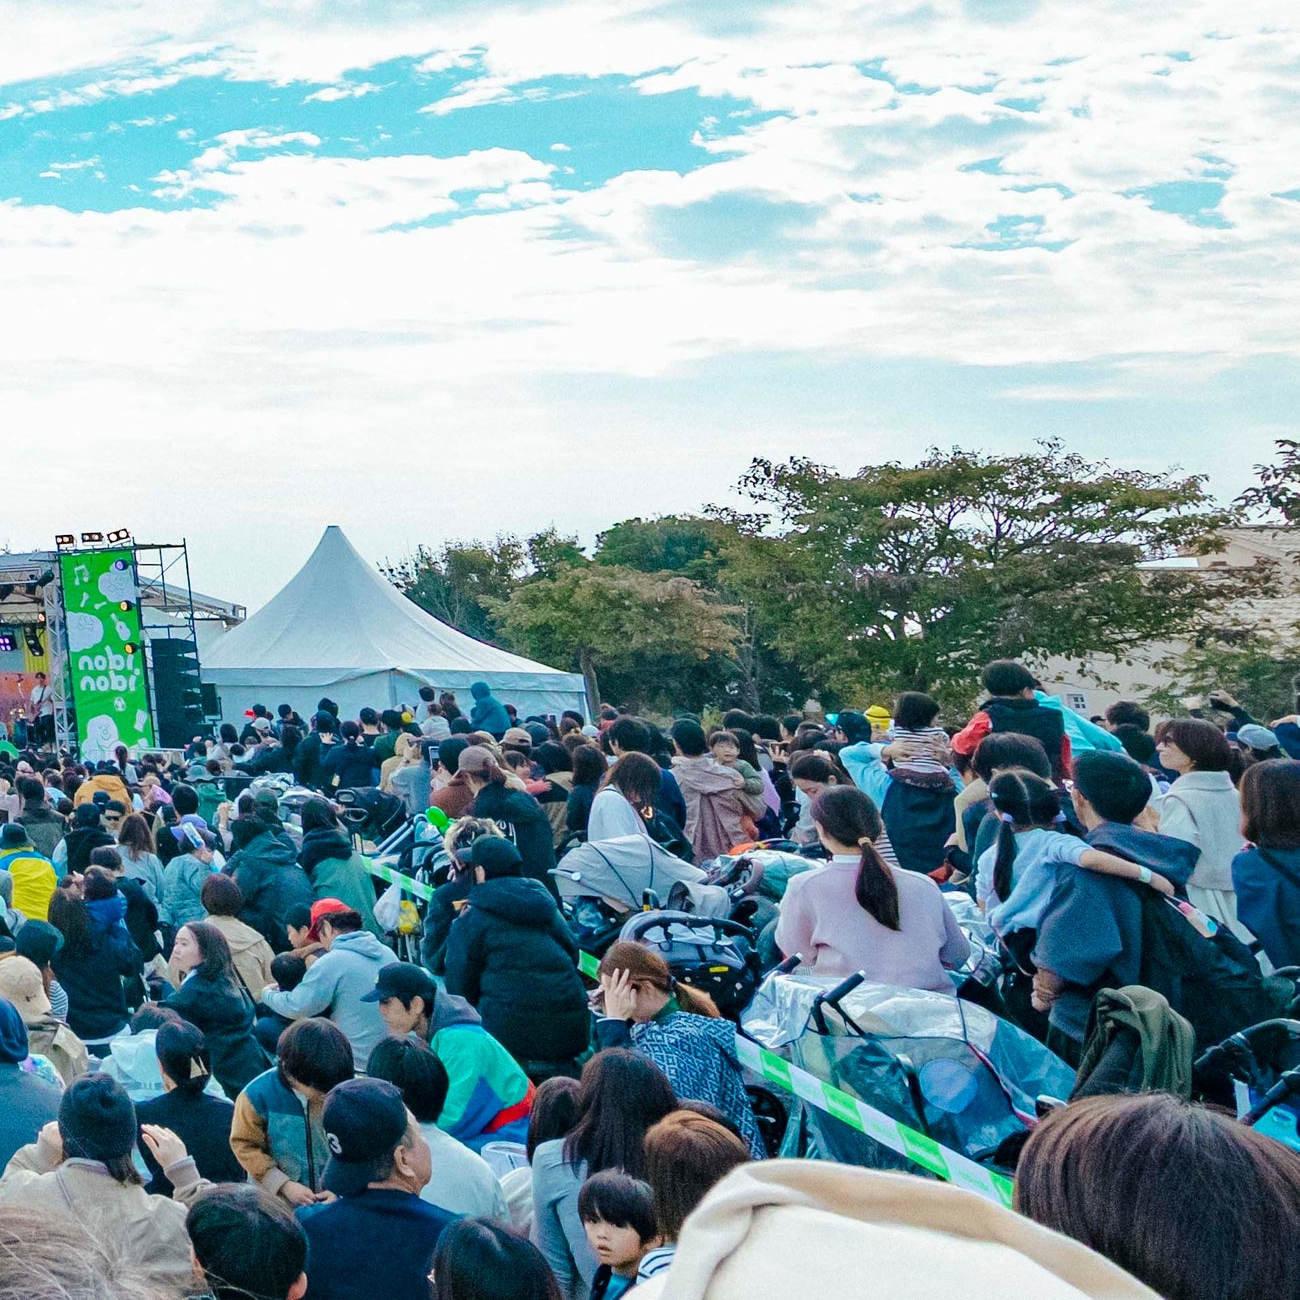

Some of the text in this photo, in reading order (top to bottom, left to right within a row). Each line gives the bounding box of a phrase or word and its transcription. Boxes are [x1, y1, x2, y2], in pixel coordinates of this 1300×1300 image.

[78, 645, 134, 671] nobi
[80, 668, 141, 691] nobi
[327, 1133, 342, 1154] 3
